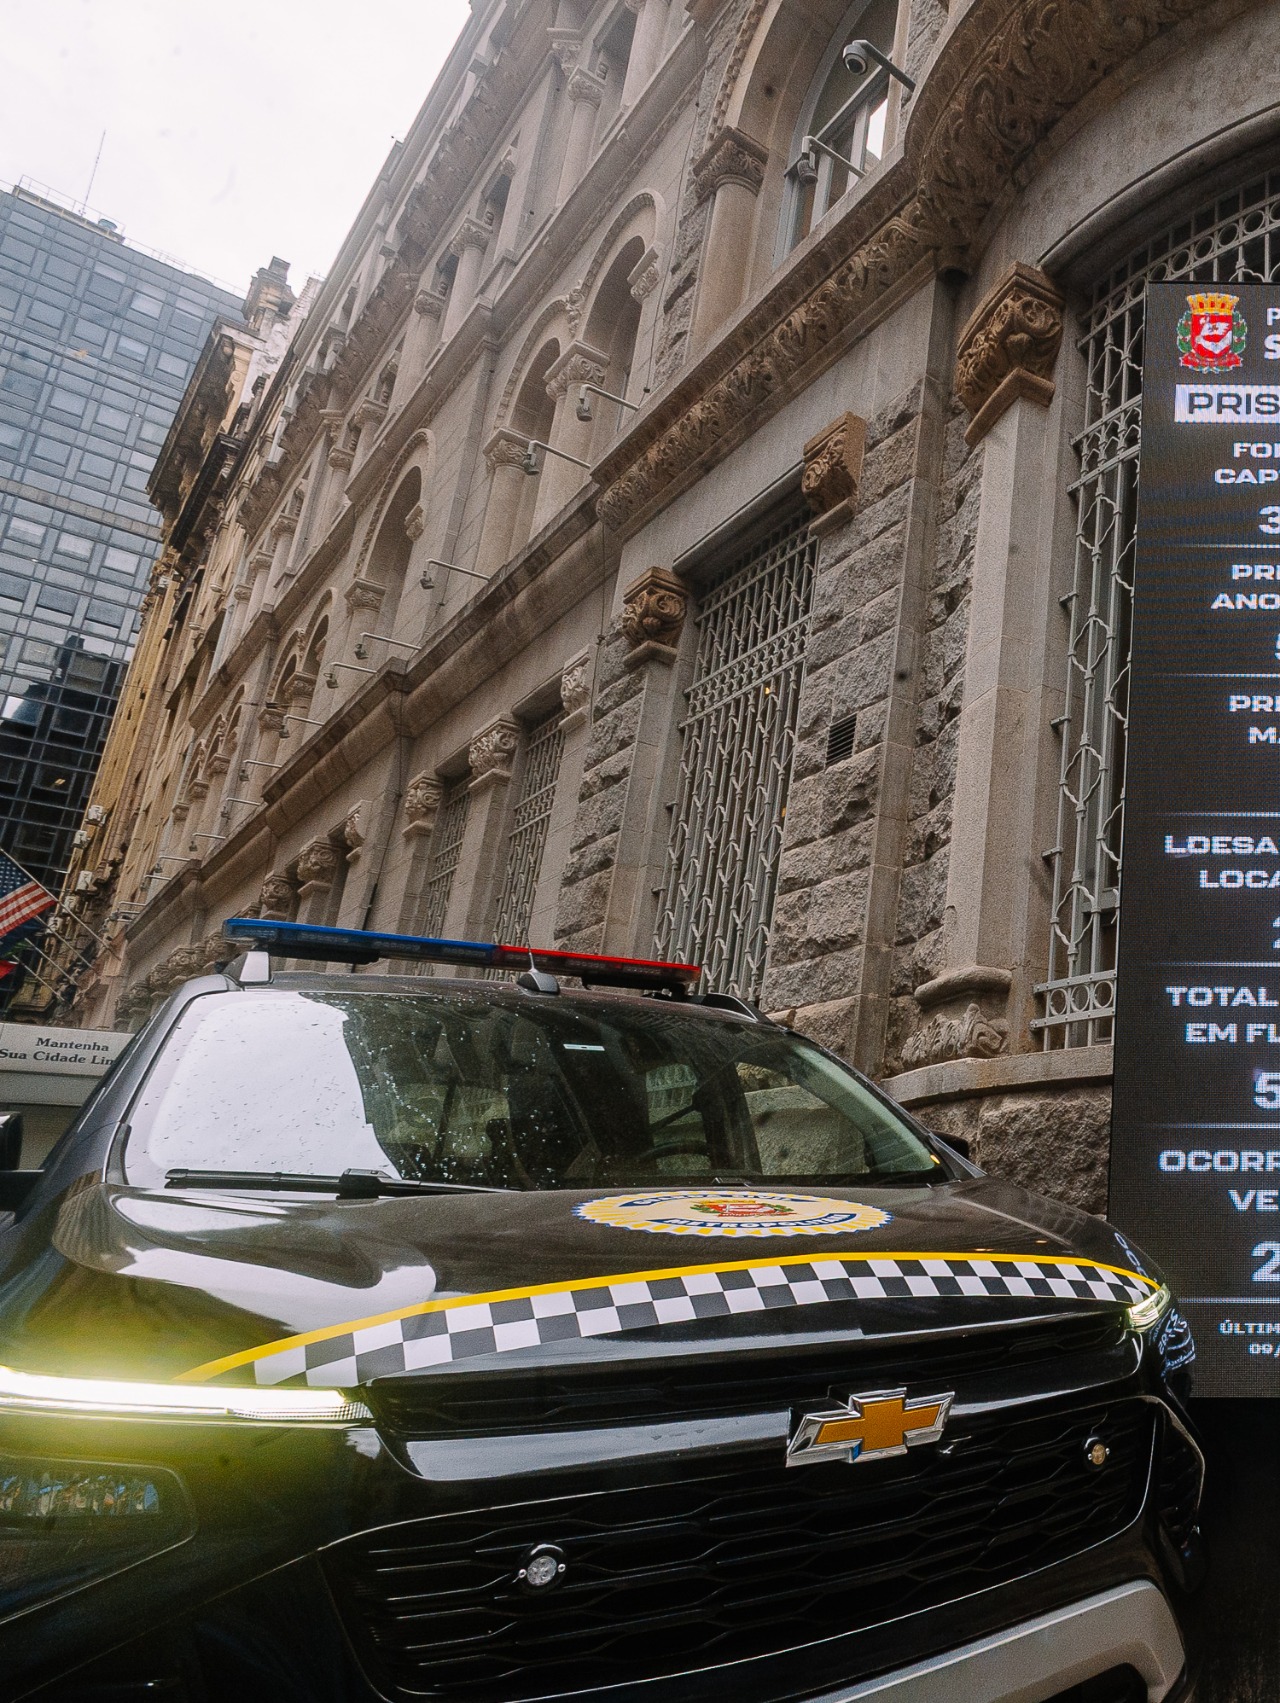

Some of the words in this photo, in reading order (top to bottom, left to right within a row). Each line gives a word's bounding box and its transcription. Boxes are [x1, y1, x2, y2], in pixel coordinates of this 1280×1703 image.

[1165, 986, 1280, 1007] TOTAL
[1185, 1022, 1238, 1043] EM
[36, 1037, 109, 1052] Mantenha
[0, 1048, 27, 1060] Sua
[33, 1050, 86, 1064] Cidade
